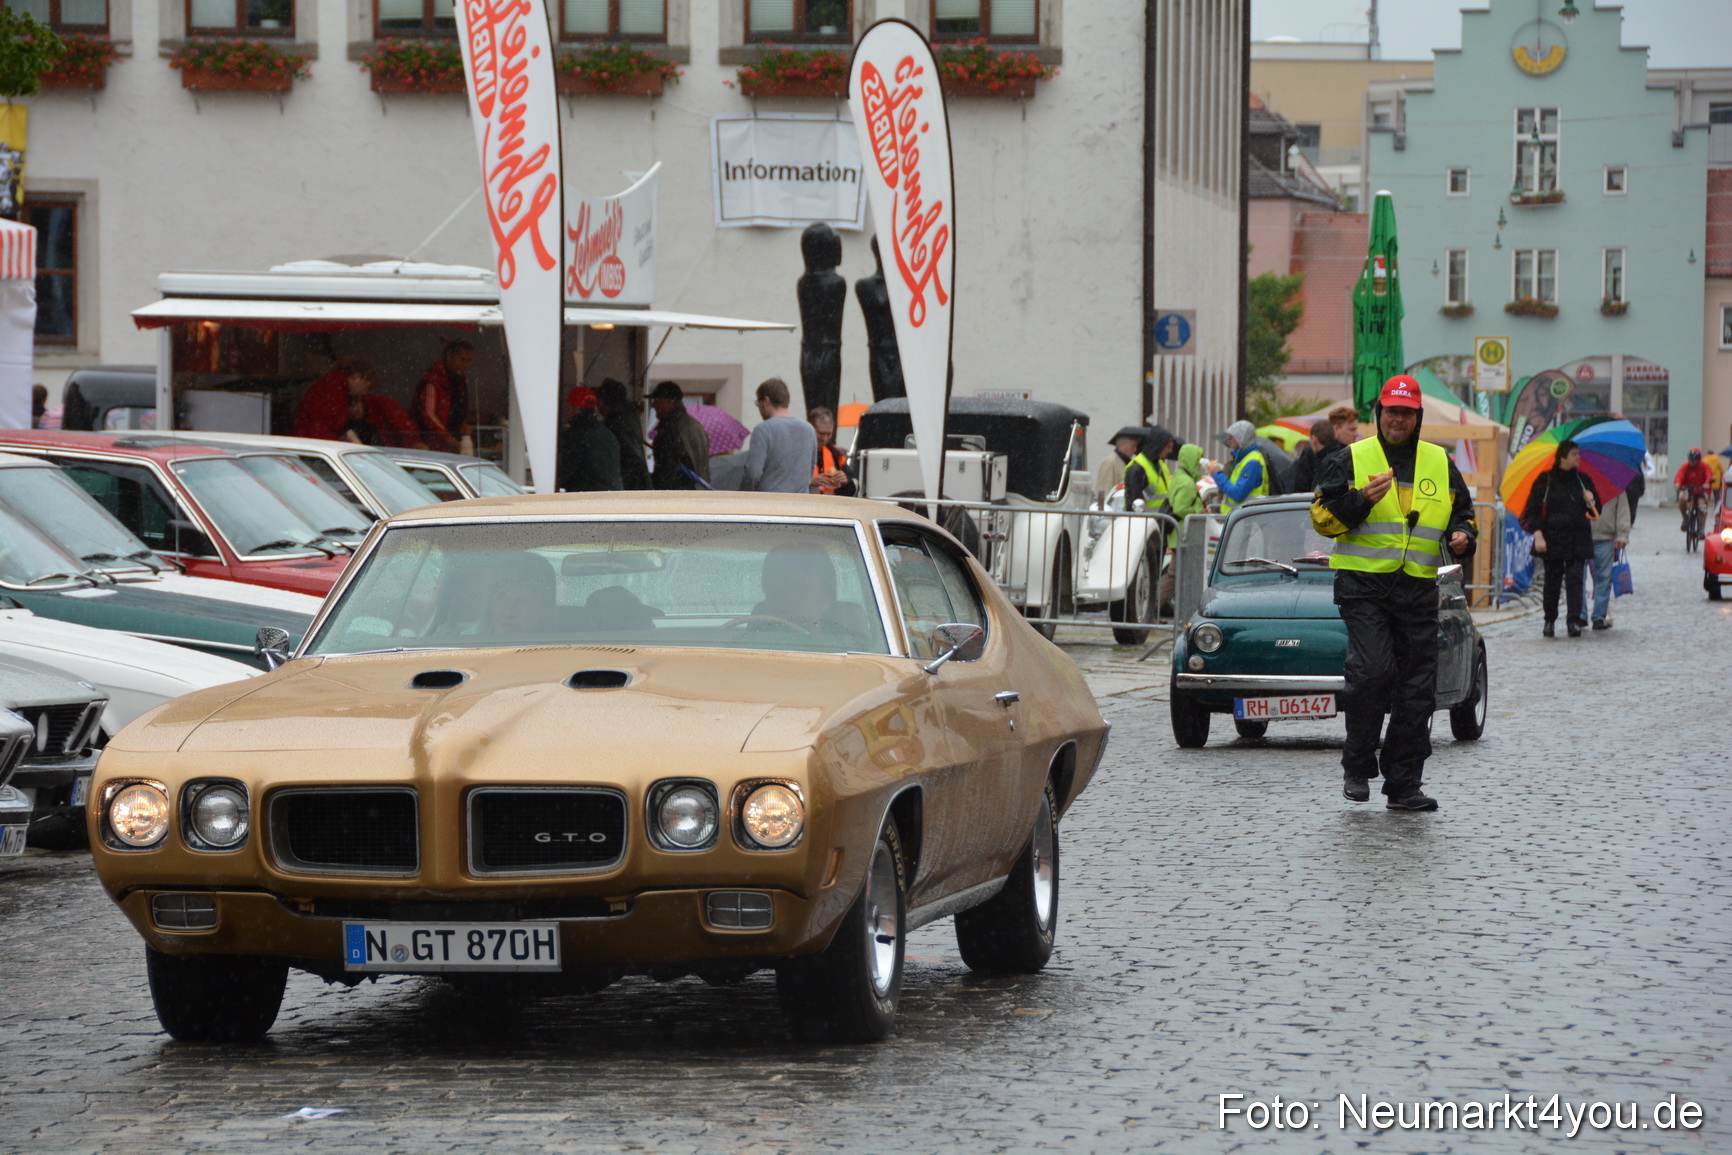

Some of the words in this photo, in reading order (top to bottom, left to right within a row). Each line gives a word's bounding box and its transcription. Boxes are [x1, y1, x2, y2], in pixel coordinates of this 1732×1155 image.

[724, 157, 857, 183] Information
[601, 262, 622, 290] IMBISS
[1391, 389, 1412, 398] DEKRA
[1246, 700, 1269, 716] RH
[1279, 697, 1331, 715] 06147
[534, 832, 607, 843] GTO
[885, 824, 905, 892] DUNLOP
[365, 930, 388, 962] N
[411, 929, 456, 961] GT
[466, 928, 555, 961] 870H
